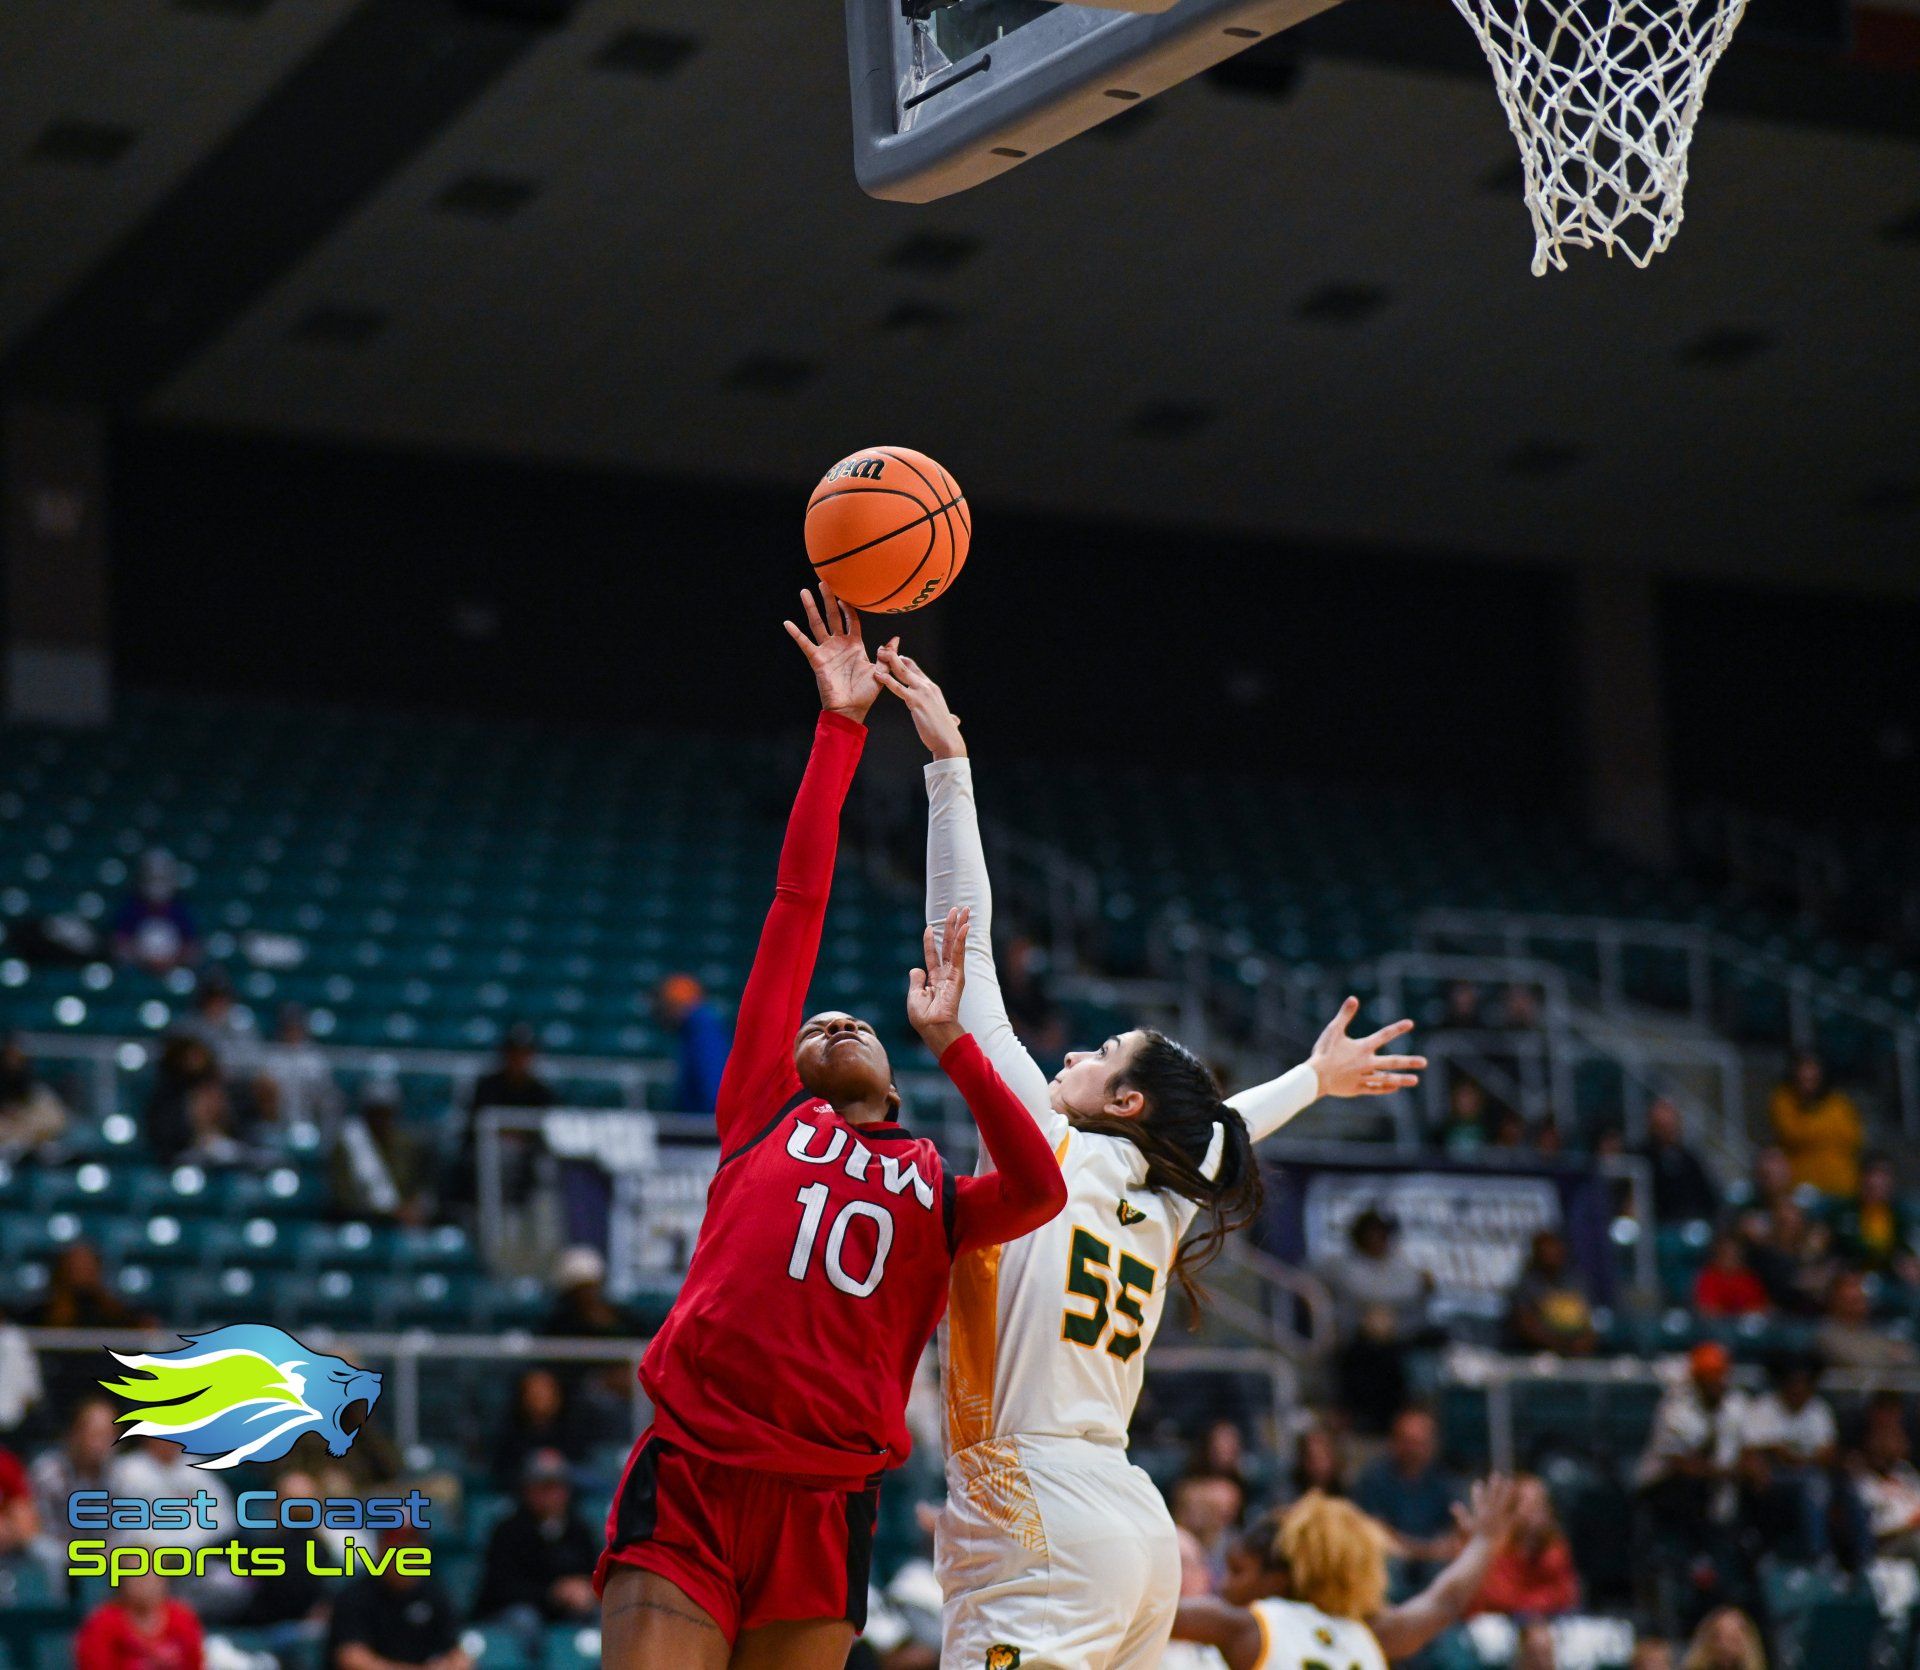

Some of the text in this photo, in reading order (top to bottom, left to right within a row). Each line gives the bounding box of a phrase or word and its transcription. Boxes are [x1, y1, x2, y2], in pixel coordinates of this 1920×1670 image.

[826, 458, 885, 482] Wil
[786, 1117, 934, 1211] UIW
[786, 1181, 895, 1299] 10
[1060, 1224, 1158, 1363] 55
